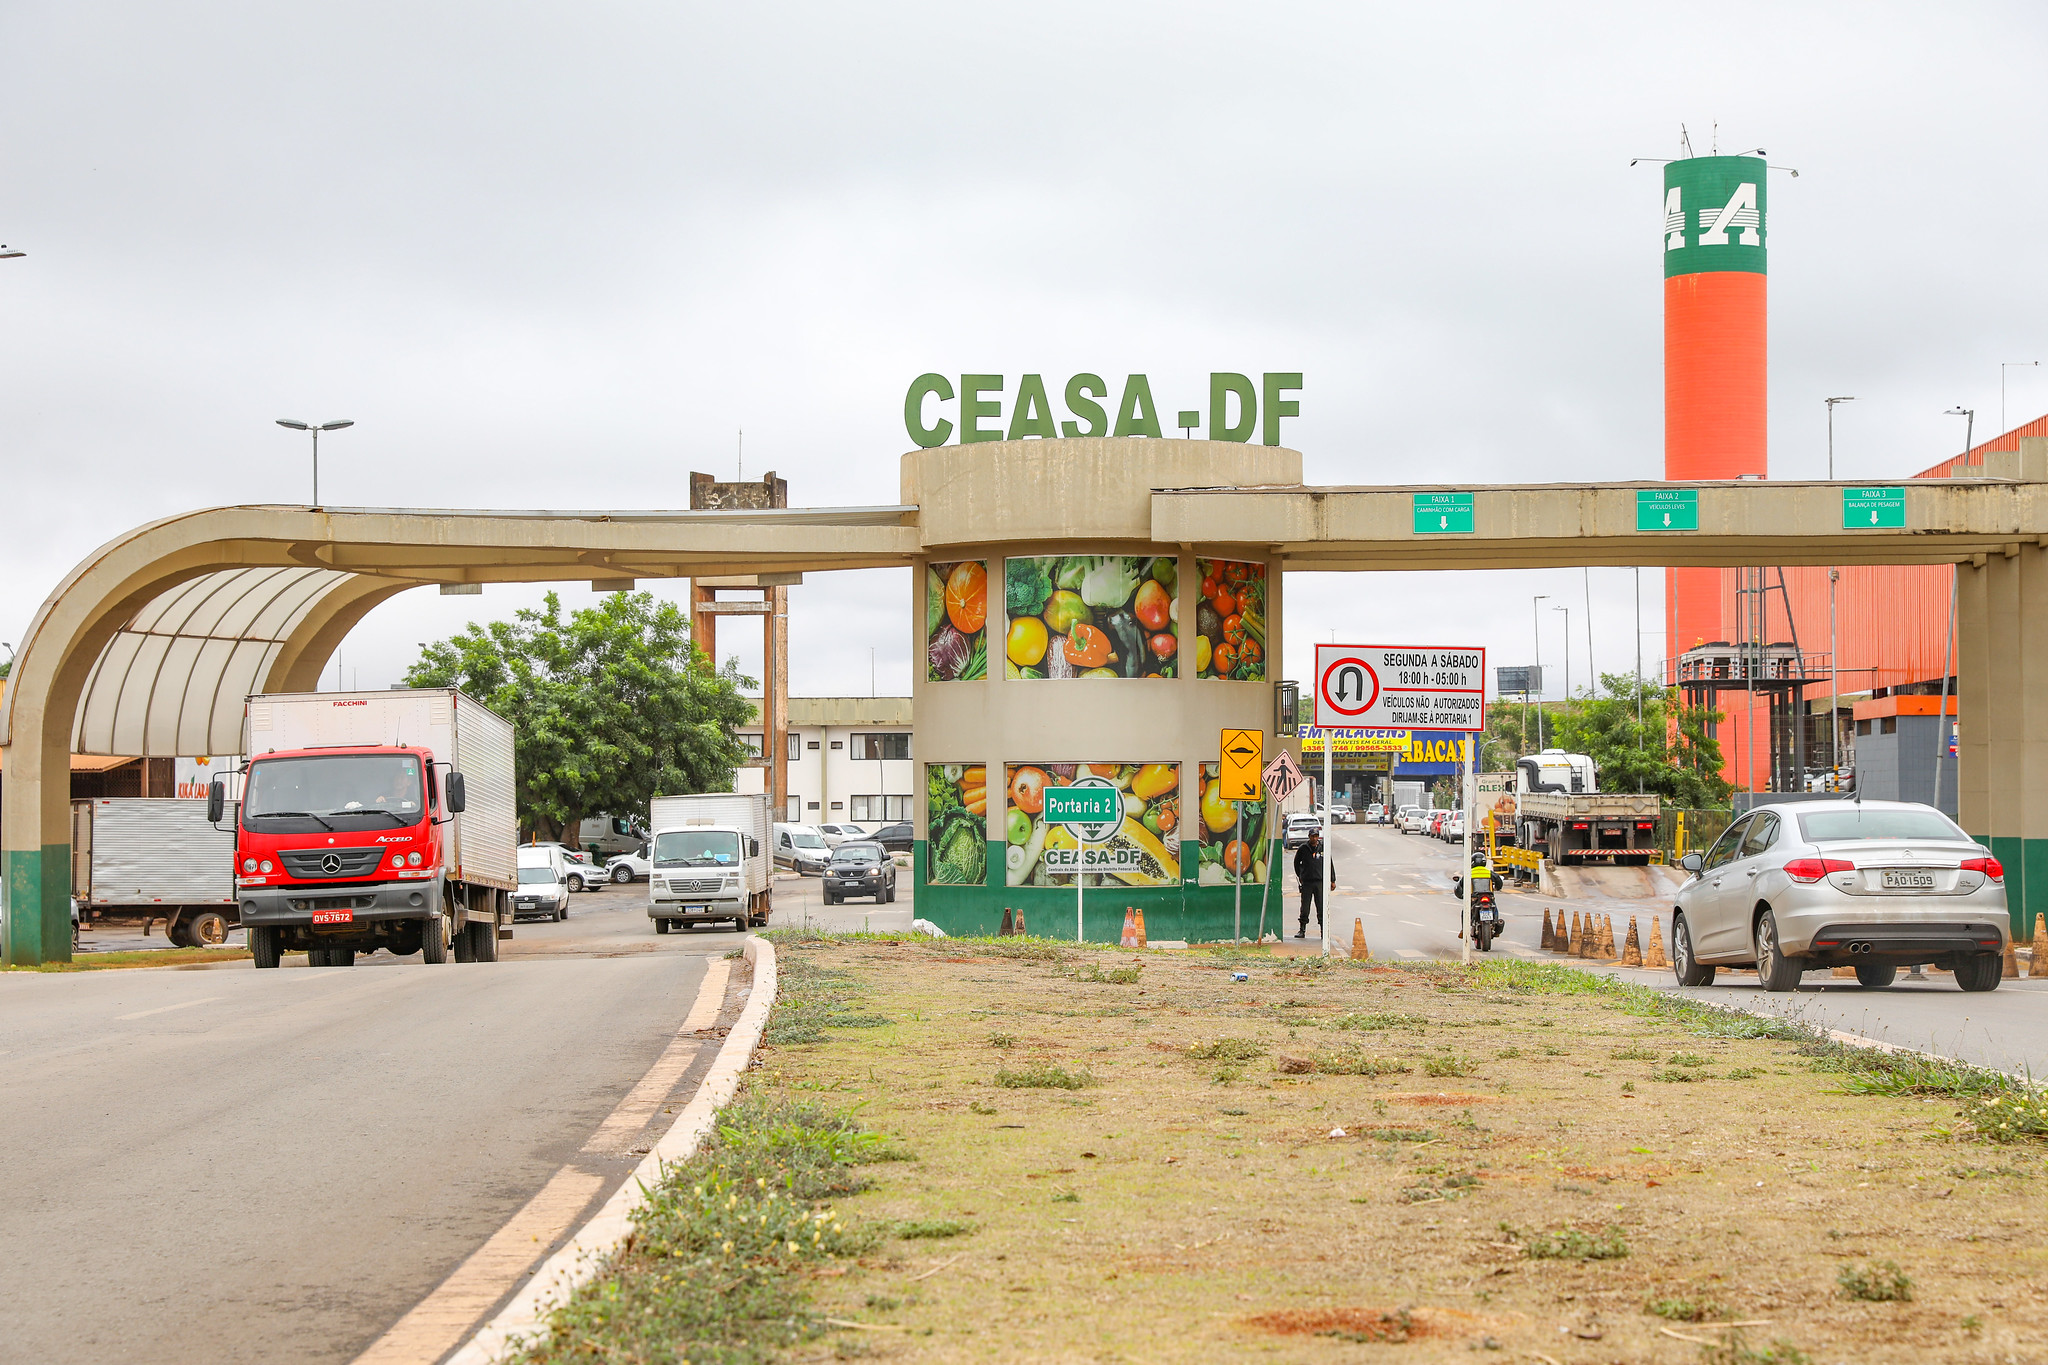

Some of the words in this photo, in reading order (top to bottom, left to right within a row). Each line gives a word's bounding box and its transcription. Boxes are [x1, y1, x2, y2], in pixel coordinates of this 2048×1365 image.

[1431, 495, 1450, 503] FAIXA
[1451, 495, 1455, 503] 1
[1655, 492, 1673, 500] FAIXA
[1675, 492, 1679, 500] 2
[1862, 490, 1880, 498] FAIXA
[1882, 490, 1886, 498] 3
[1383, 653, 1428, 667] SEGUNDA
[1431, 654, 1438, 667] A
[1440, 652, 1479, 668] SÁBADO
[1398, 671, 1421, 685] 18:00
[1424, 671, 1429, 684] h
[1461, 672, 1467, 685] h
[1382, 694, 1415, 708] VEÍCULOS
[1416, 695, 1430, 708] NÃO
[1392, 711, 1428, 724] DIRIJAM-SE
[1435, 713, 1467, 724] PORTARIA
[1469, 713, 1472, 724] 1
[1298, 725, 1407, 739] EMALAGENS
[1049, 798, 1100, 813] Portaria
[1104, 798, 1111, 813] 2
